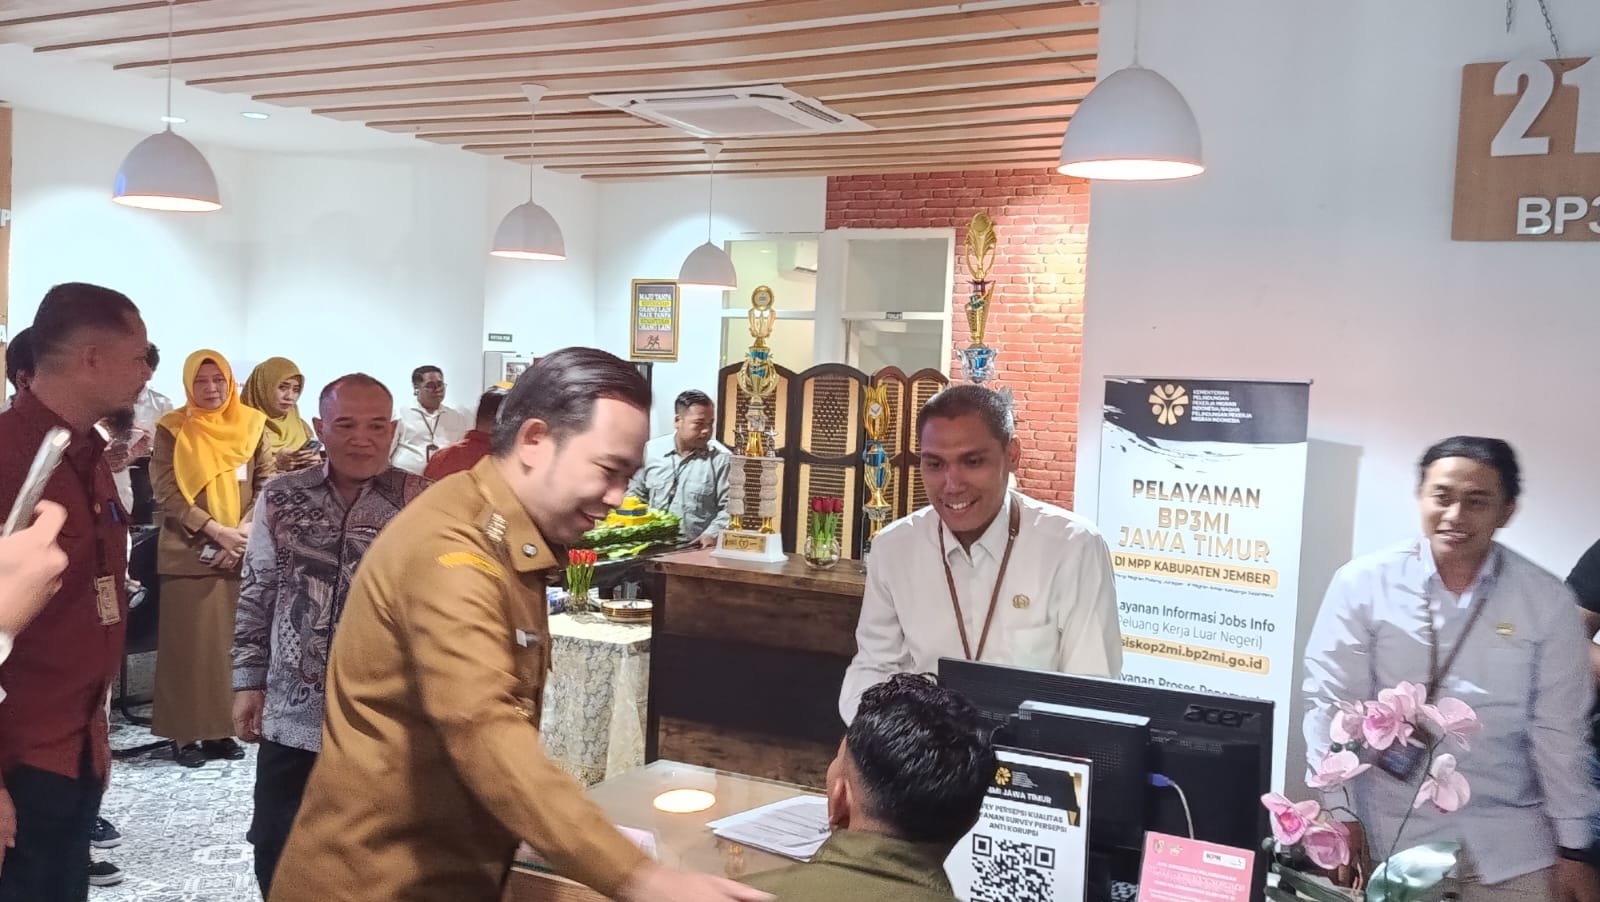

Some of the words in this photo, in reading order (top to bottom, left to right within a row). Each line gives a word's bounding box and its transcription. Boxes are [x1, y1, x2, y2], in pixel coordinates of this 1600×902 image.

[1490, 56, 1600, 157] 21
[1132, 479, 1261, 508] PELAYANAN
[1158, 507, 1230, 535] BP3MI
[1118, 526, 1186, 554] JAWA
[1194, 534, 1271, 564] TIMUR
[1114, 556, 1126, 567] DI
[1128, 558, 1151, 570] MPP
[1154, 560, 1221, 578] KABUPATEN
[1223, 569, 1271, 585] JEMBER
[1119, 602, 1160, 616] ayanan
[1162, 605, 1216, 624] Informasi
[1219, 614, 1247, 628] Jobs
[1250, 618, 1276, 632] Info
[1162, 624, 1190, 638] Kerja
[1194, 627, 1216, 641] Luar
[1220, 630, 1262, 650] Negeri)
[1121, 638, 1262, 670] siskop2mi.bp2mi.go.id
[1184, 704, 1262, 728] acer
[1003, 788, 1026, 800] JAWA
[1028, 792, 1052, 804] TIMUR
[995, 804, 1027, 816] PERSEPSI
[1028, 810, 1063, 823] KUALITAS
[1006, 815, 1033, 826] SURVEY
[1034, 821, 1067, 833] PERSEPSI
[989, 823, 1007, 831] ANTI
[1007, 825, 1039, 837] KORUPSI
